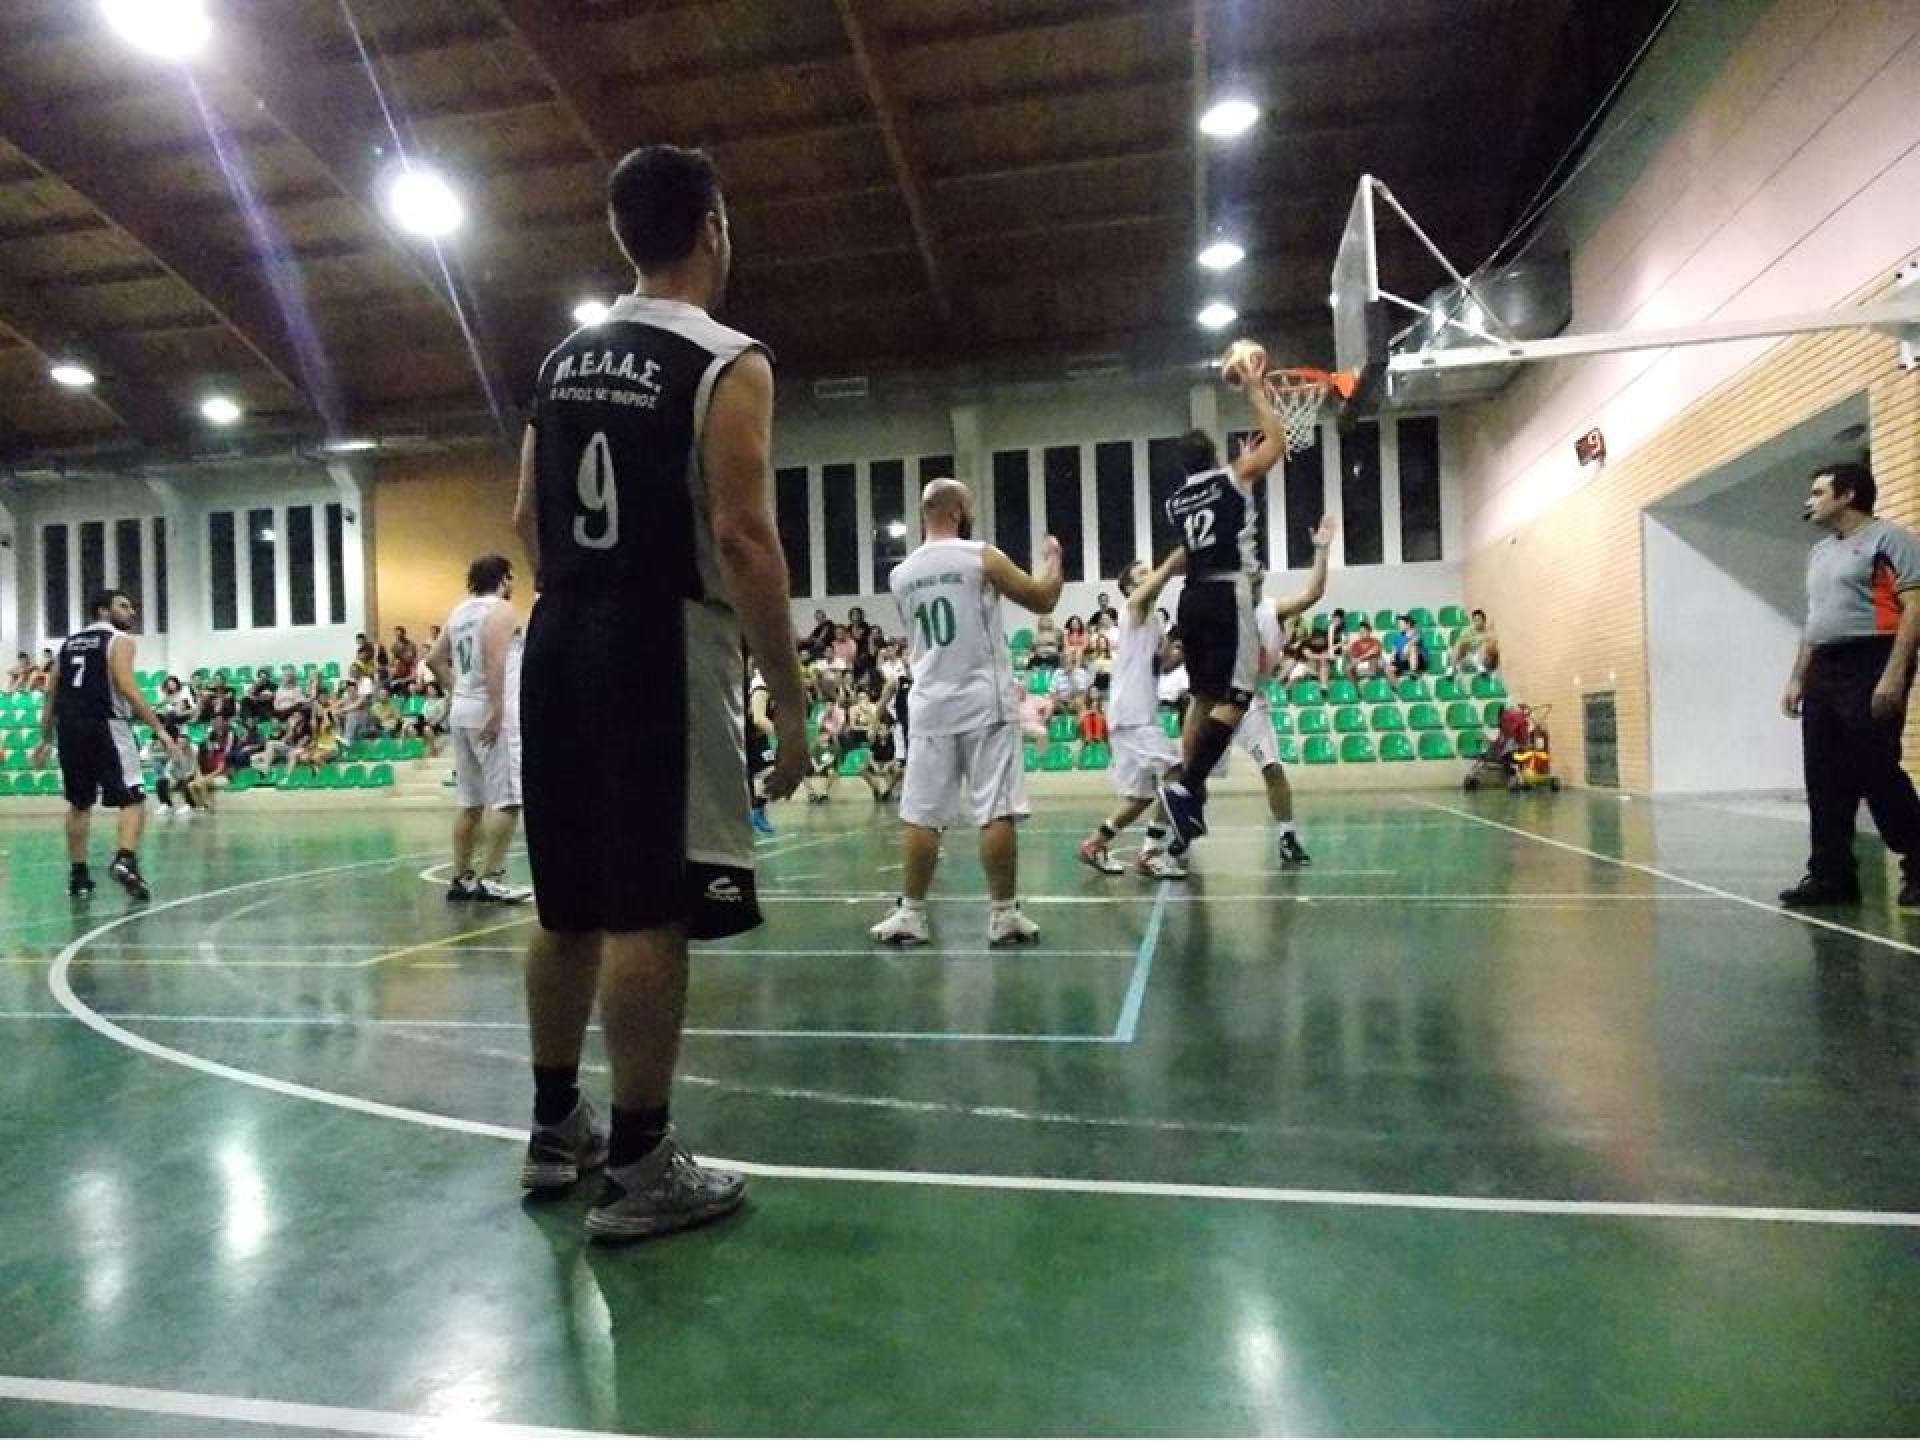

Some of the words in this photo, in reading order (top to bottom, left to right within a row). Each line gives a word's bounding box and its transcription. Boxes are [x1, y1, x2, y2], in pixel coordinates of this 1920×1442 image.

[573, 431, 619, 549] 9
[1183, 509, 1217, 551] 12
[914, 596, 957, 650] 10
[72, 655, 86, 688] 7
